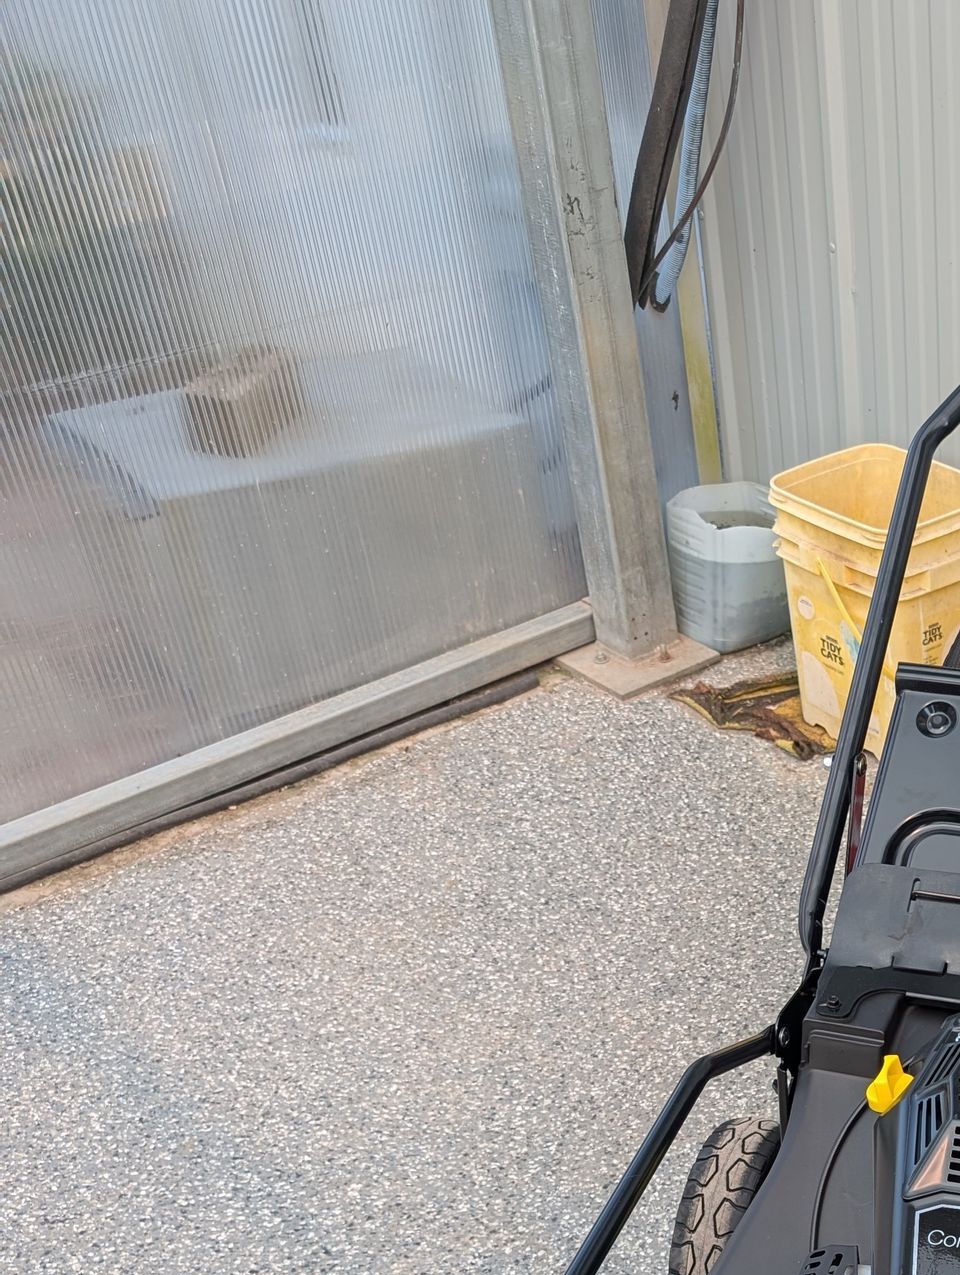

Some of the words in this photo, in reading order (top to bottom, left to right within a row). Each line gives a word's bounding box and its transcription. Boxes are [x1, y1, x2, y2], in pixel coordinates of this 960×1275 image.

[922, 625, 941, 639] TIDY
[922, 632, 943, 646] CATS
[820, 638, 841, 656] TIDY
[820, 648, 845, 666] CATS
